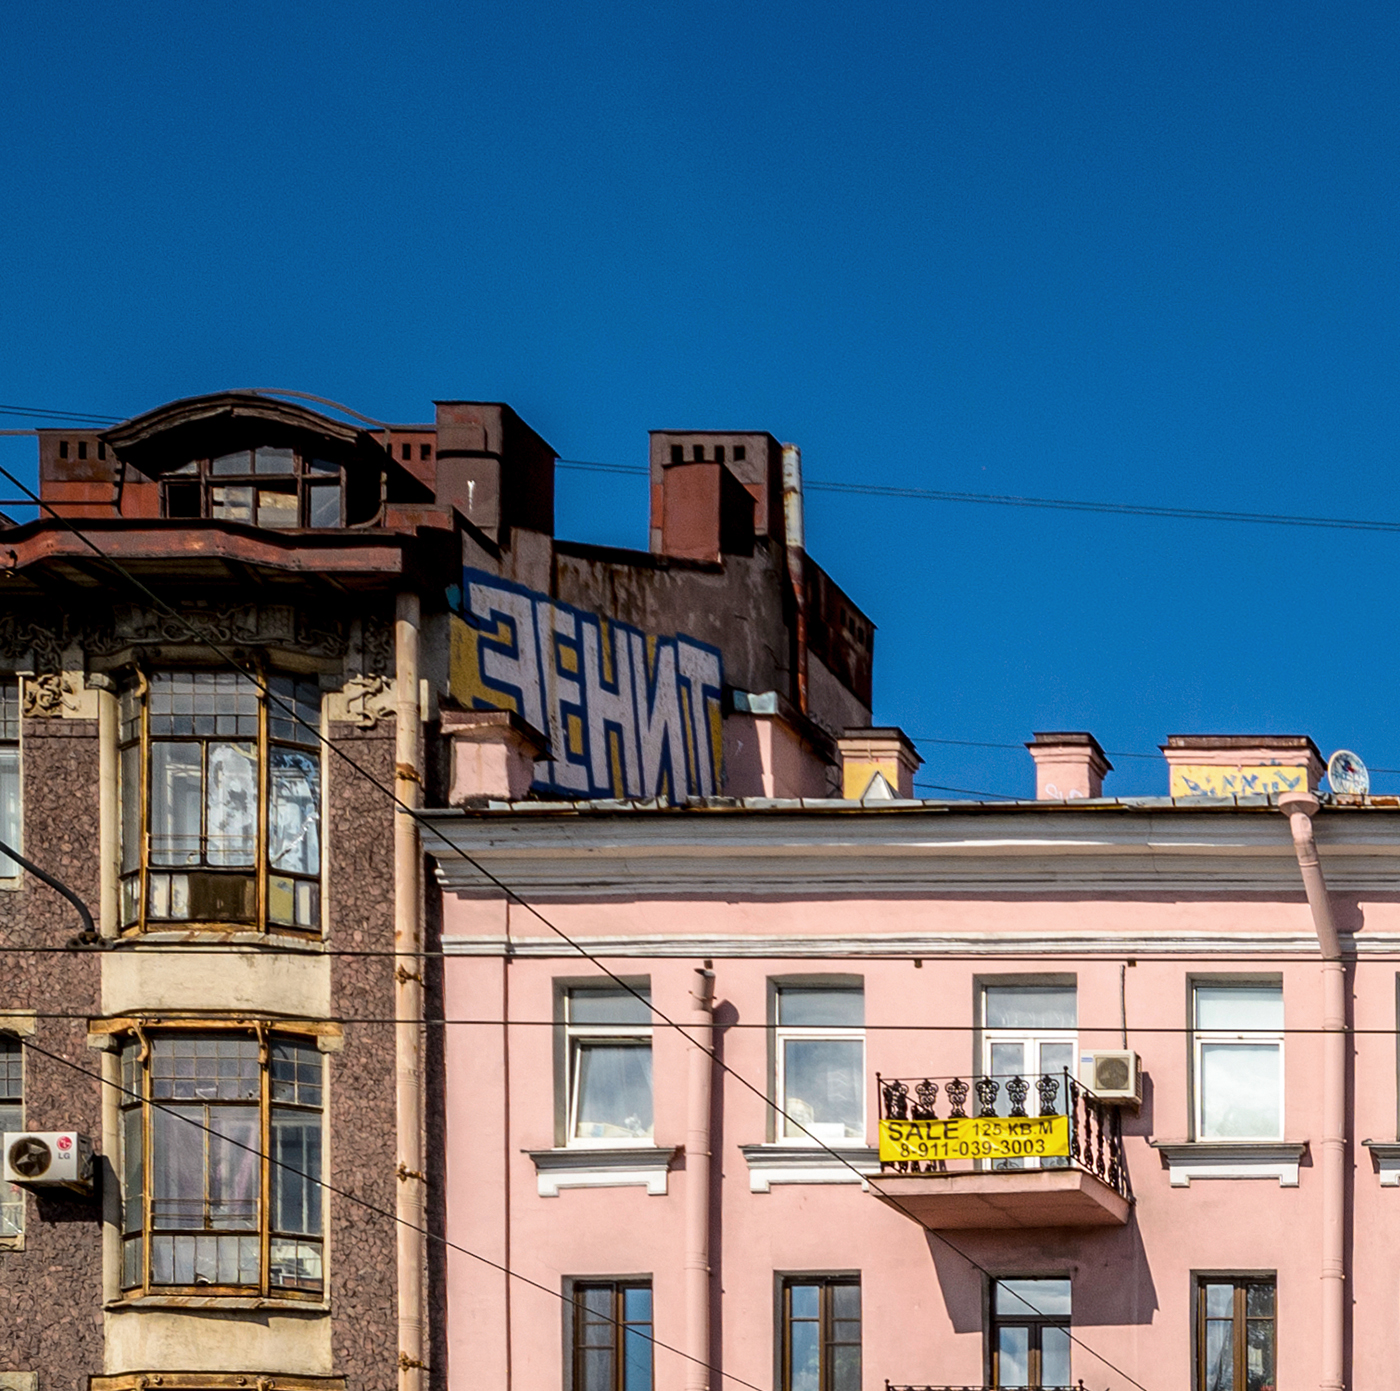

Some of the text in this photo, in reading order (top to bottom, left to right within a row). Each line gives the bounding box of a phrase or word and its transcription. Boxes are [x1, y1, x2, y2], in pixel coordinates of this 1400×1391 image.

[459, 566, 722, 803] ЗЕНИТ
[888, 1120, 959, 1141] SALE
[972, 1123, 1002, 1136] 125
[58, 1152, 71, 1160] LG
[900, 1139, 1045, 1158] 8-911-039-3003
